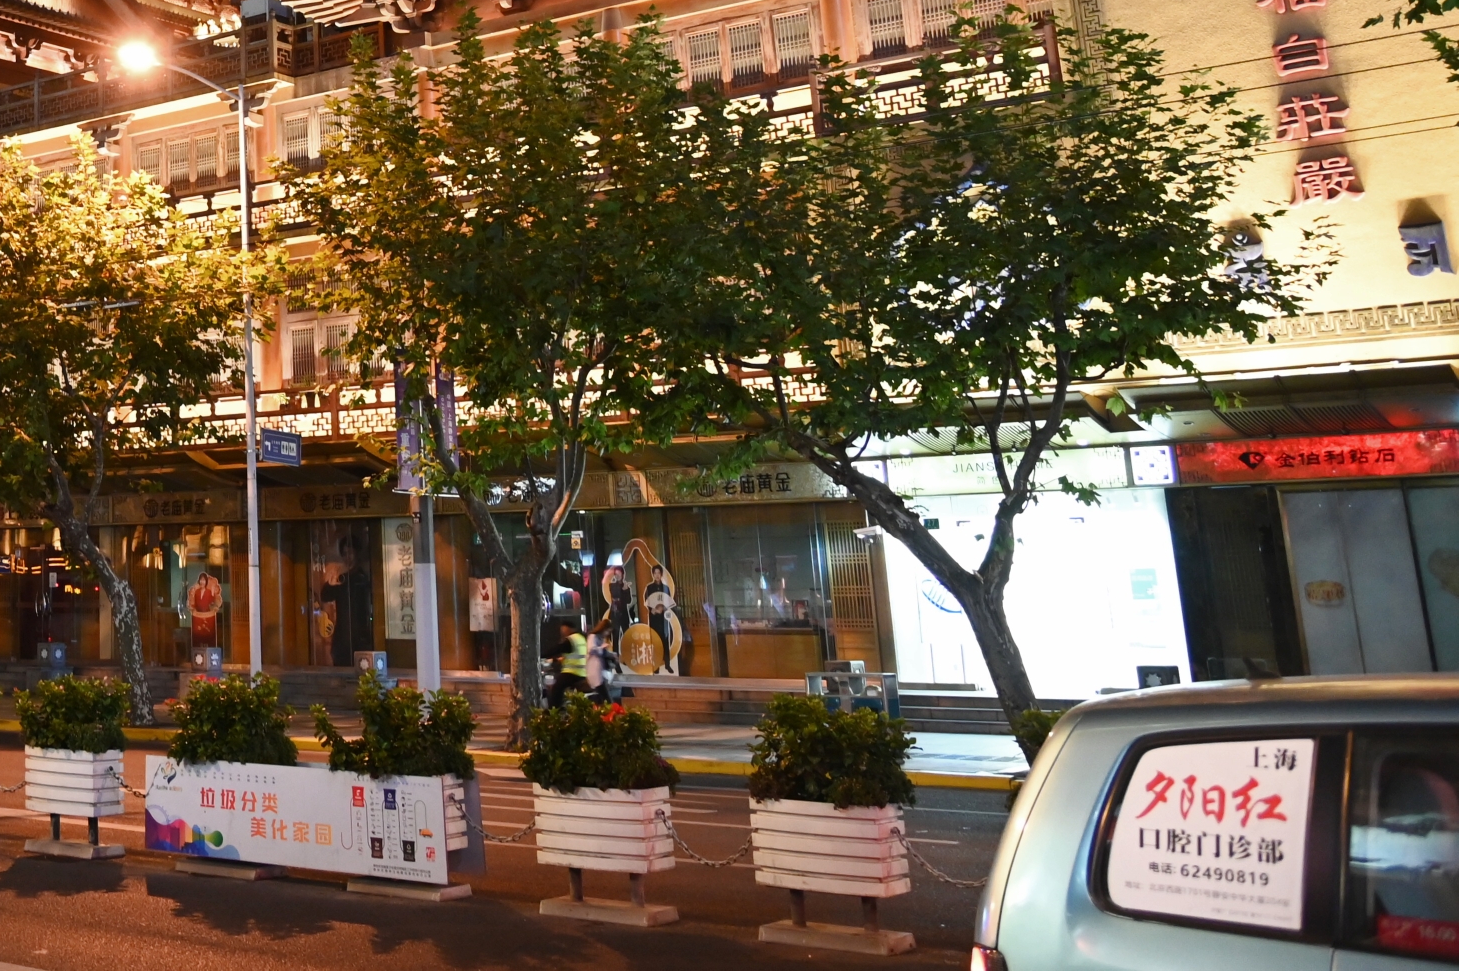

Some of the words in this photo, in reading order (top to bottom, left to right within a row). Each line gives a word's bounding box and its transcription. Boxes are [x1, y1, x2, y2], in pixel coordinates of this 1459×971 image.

[1275, 449, 1395, 468] 金伯利钻石
[319, 491, 371, 511] 老庙黄金
[399, 545, 416, 635] 老庙黄金
[1246, 746, 1298, 771] 上海
[199, 786, 279, 814] 垃圾分类
[1136, 770, 1288, 828] 夕阳红
[250, 816, 333, 846] 美化家园
[1139, 827, 1284, 864] 口腔门诊部
[1180, 863, 1270, 887] 62490819
